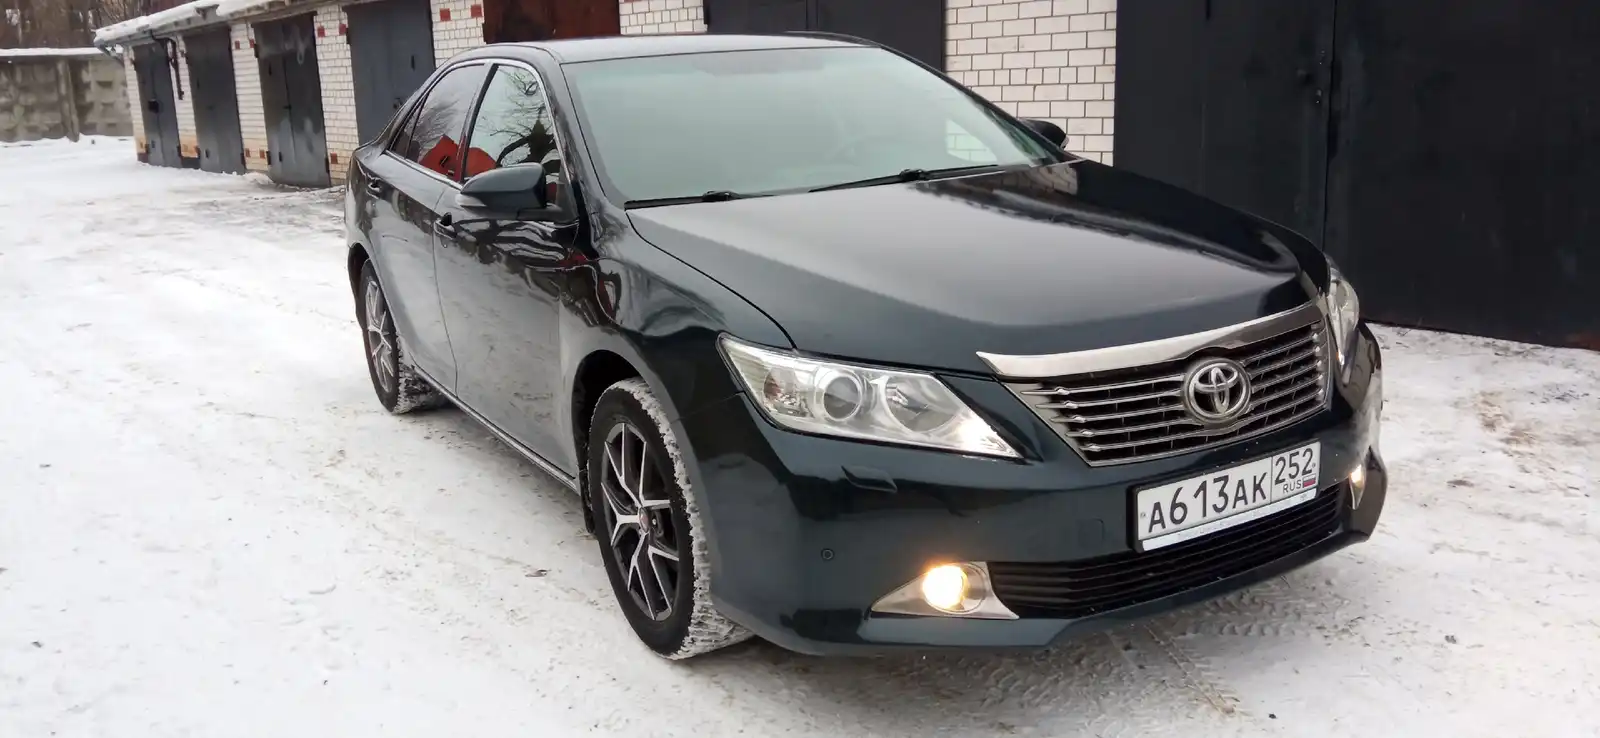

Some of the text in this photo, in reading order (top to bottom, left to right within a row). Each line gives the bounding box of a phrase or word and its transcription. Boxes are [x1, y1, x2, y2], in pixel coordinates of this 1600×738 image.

[1148, 472, 1267, 533] А613АК
[1274, 448, 1314, 486] 252
[1282, 479, 1302, 493] RUS
